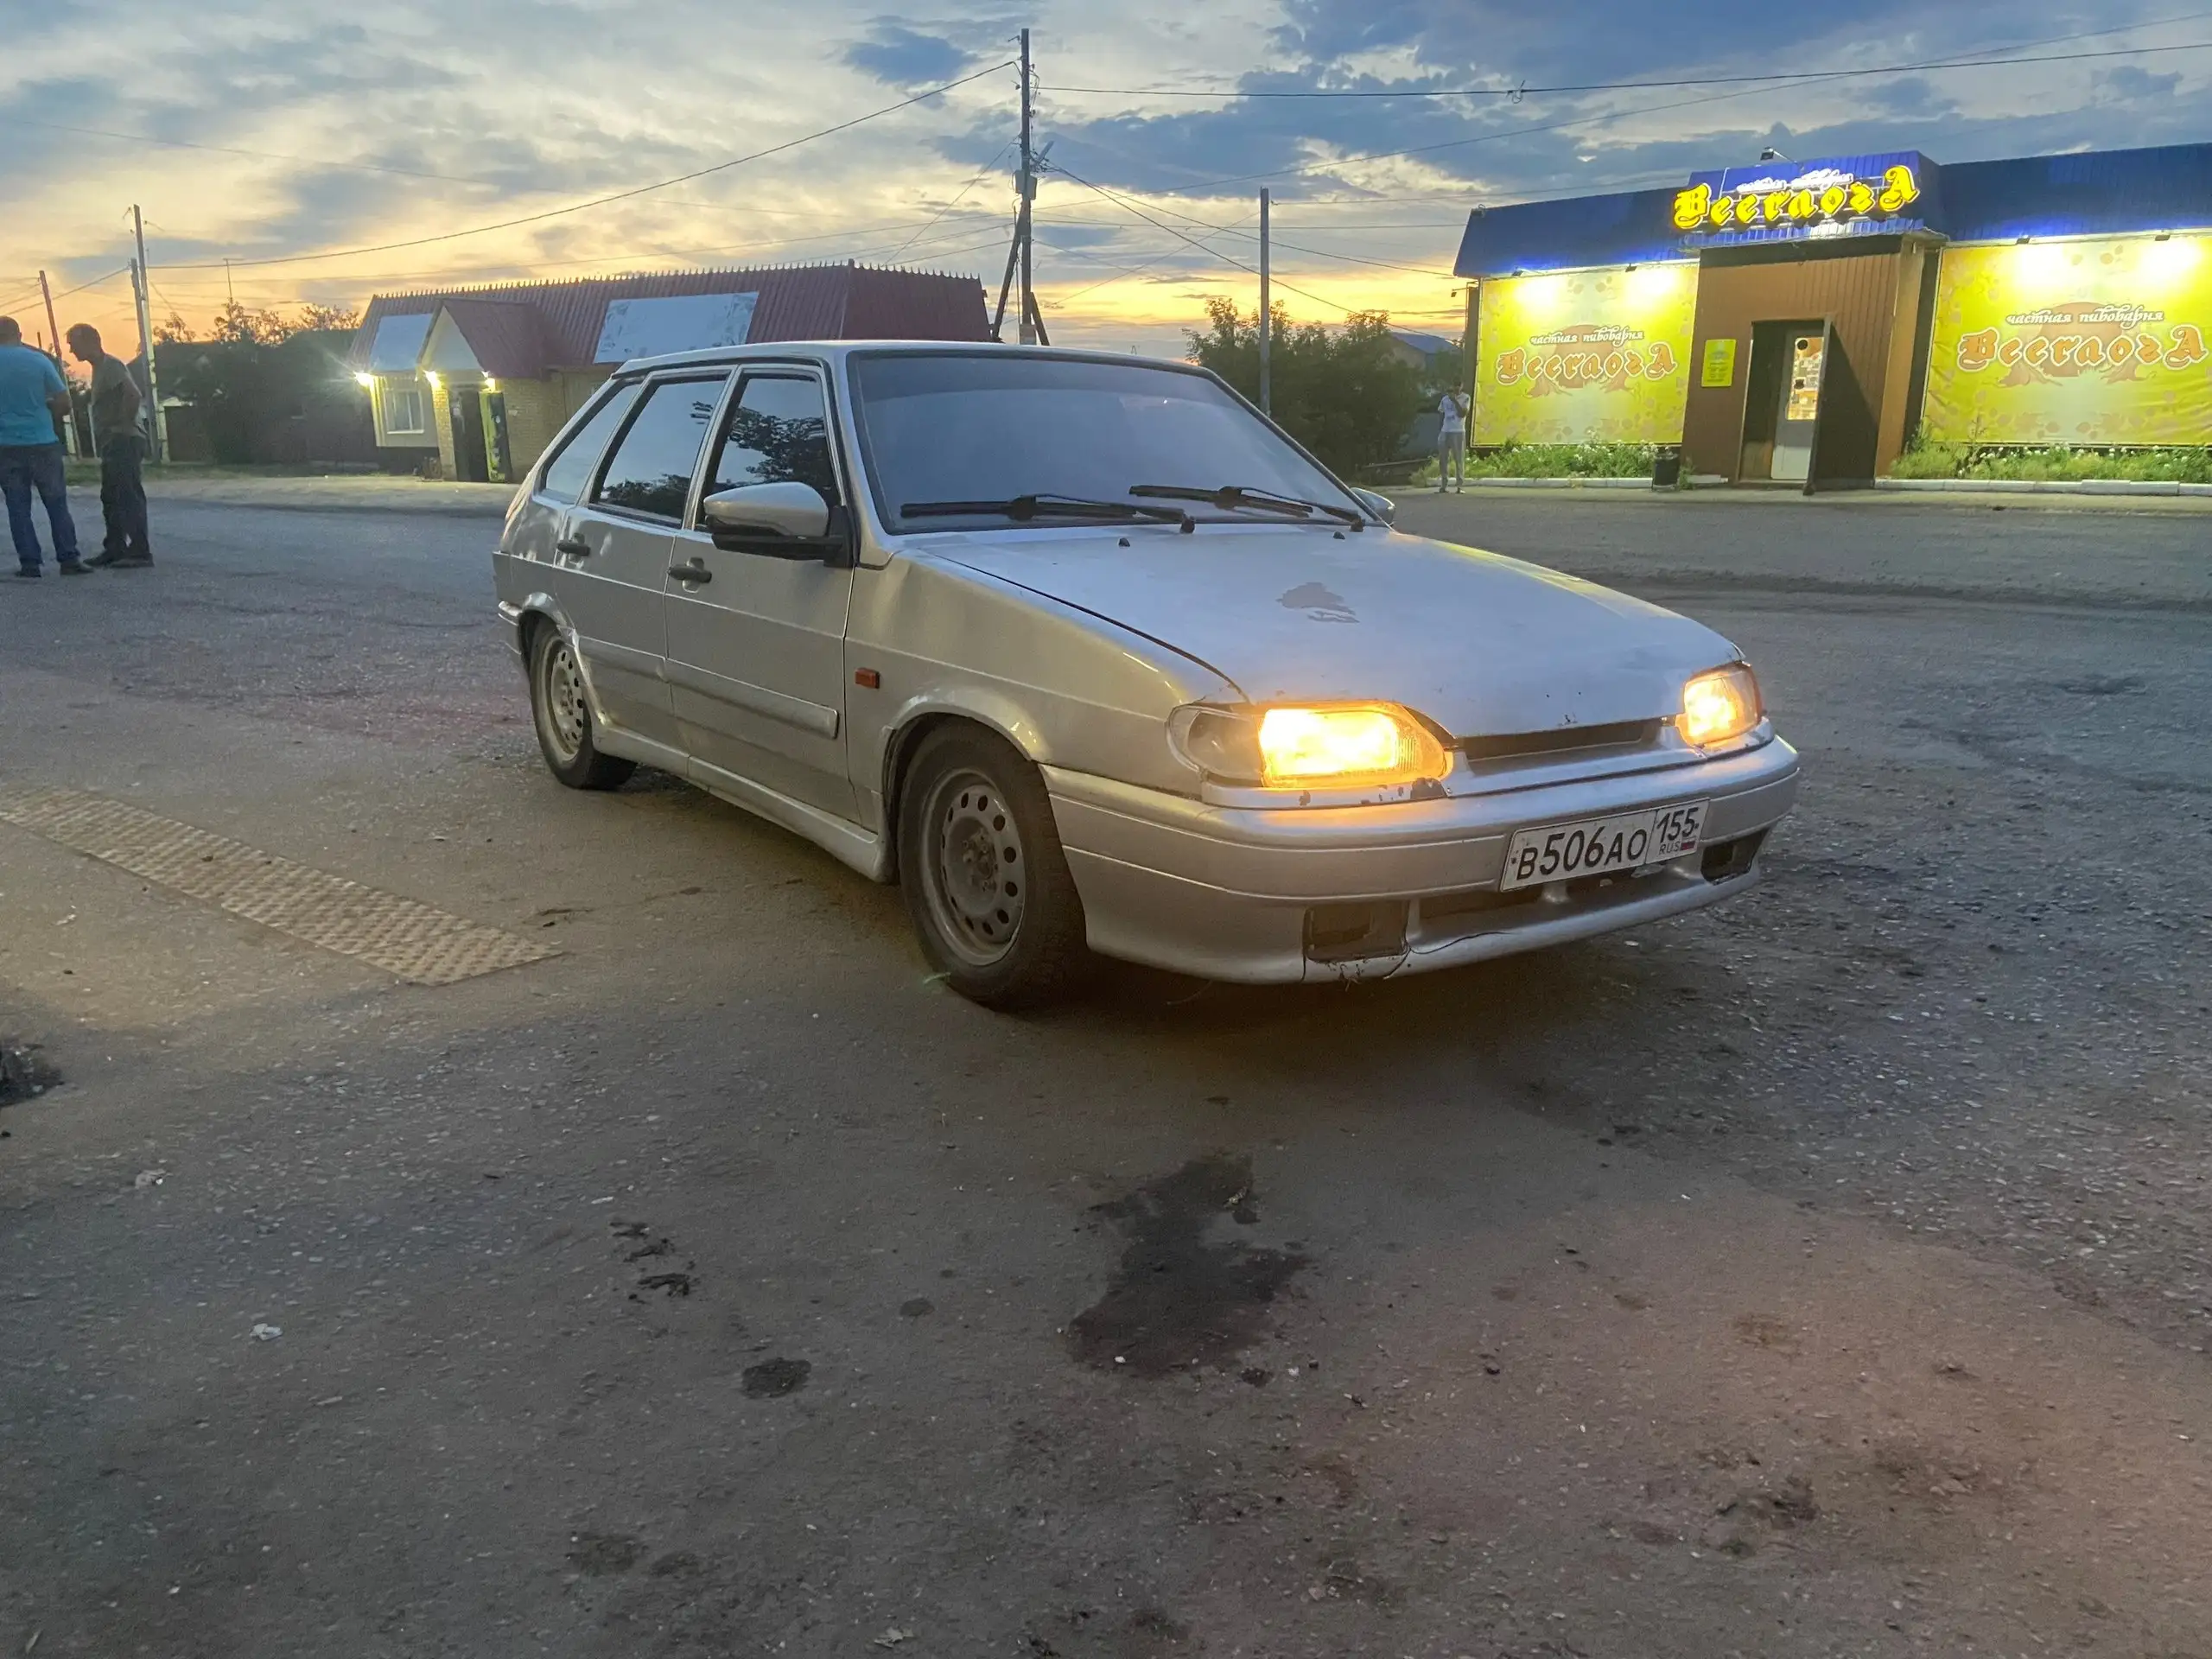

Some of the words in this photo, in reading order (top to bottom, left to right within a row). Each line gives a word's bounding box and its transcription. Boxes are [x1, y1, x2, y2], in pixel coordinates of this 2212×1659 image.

[2006, 310, 2072, 324] частная
[2078, 304, 2164, 329] пивоварня
[1530, 332, 1578, 345] частная
[1583, 326, 1644, 346] пивоварня
[1656, 807, 1699, 843] 155
[1658, 841, 1681, 855] RUS
